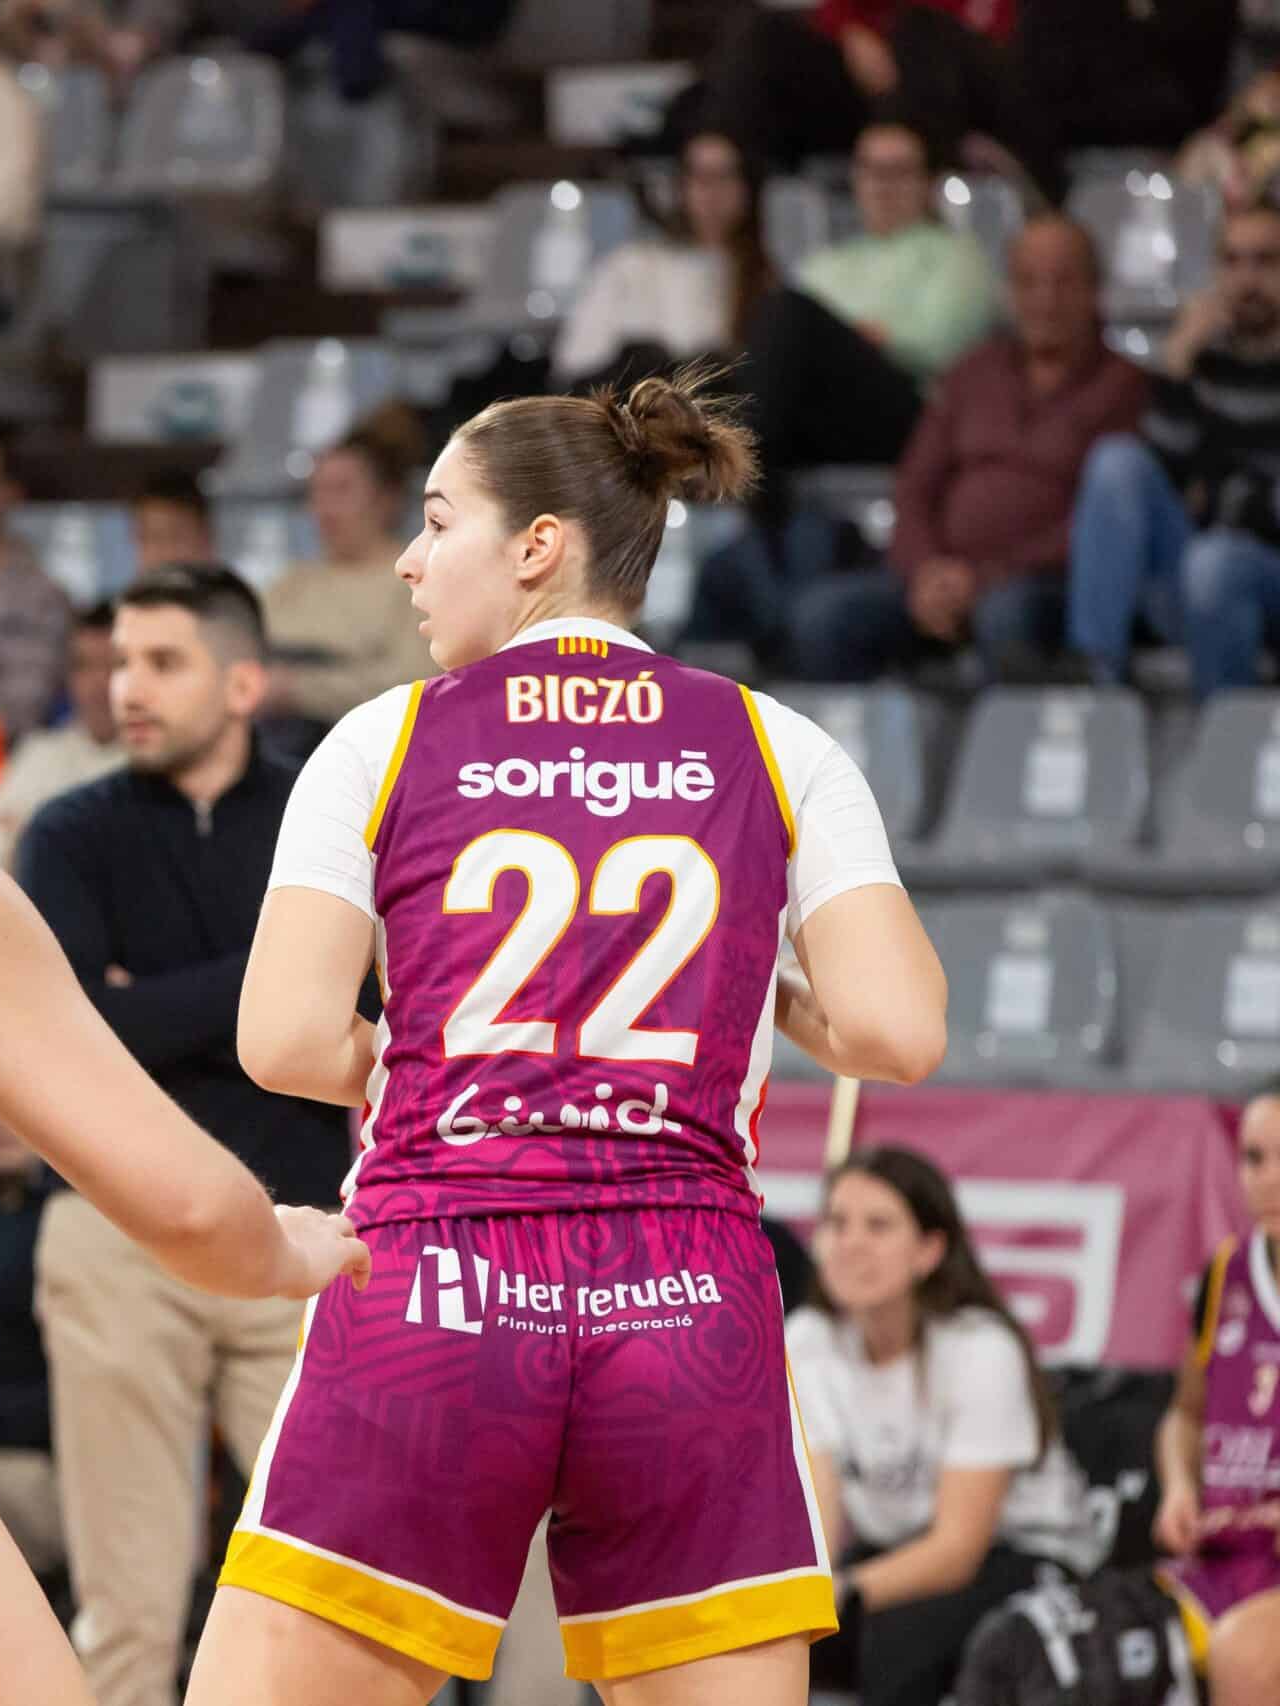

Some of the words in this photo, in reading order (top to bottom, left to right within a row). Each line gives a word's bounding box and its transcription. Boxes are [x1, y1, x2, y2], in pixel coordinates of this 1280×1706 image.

[506, 671, 663, 725] BICZÓ
[442, 828, 720, 1067] 22
[498, 1270, 722, 1317] Herreruela
